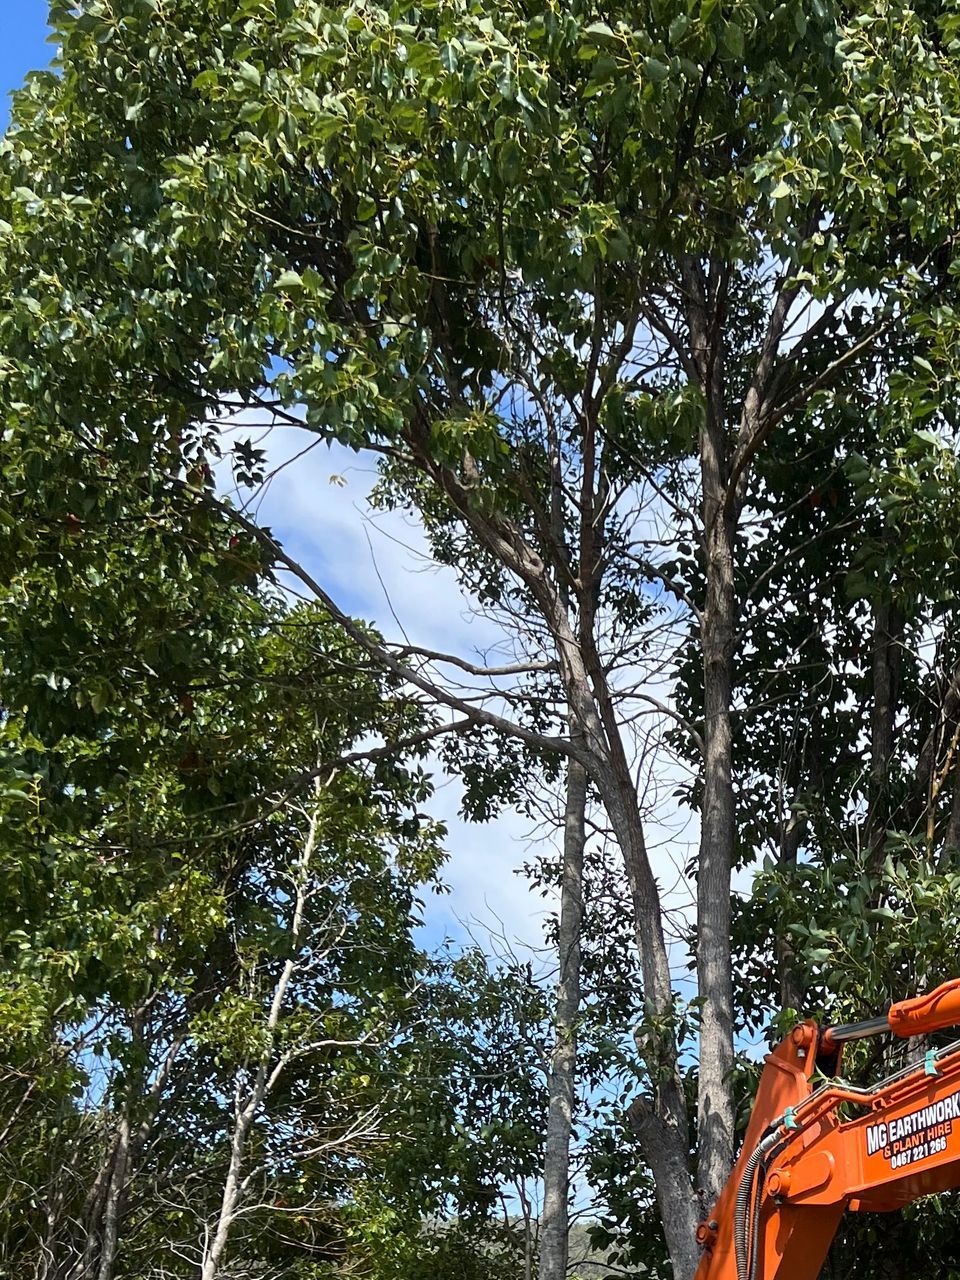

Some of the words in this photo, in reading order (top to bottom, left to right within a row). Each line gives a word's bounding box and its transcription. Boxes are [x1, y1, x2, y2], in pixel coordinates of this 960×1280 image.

[866, 1123, 888, 1156] MG
[884, 1145, 892, 1158] &
[893, 1131, 925, 1154] PLANT
[927, 1121, 951, 1141] HIRE
[891, 1149, 911, 1169] 0467
[912, 1143, 929, 1161] 221
[929, 1136, 947, 1155] 266
